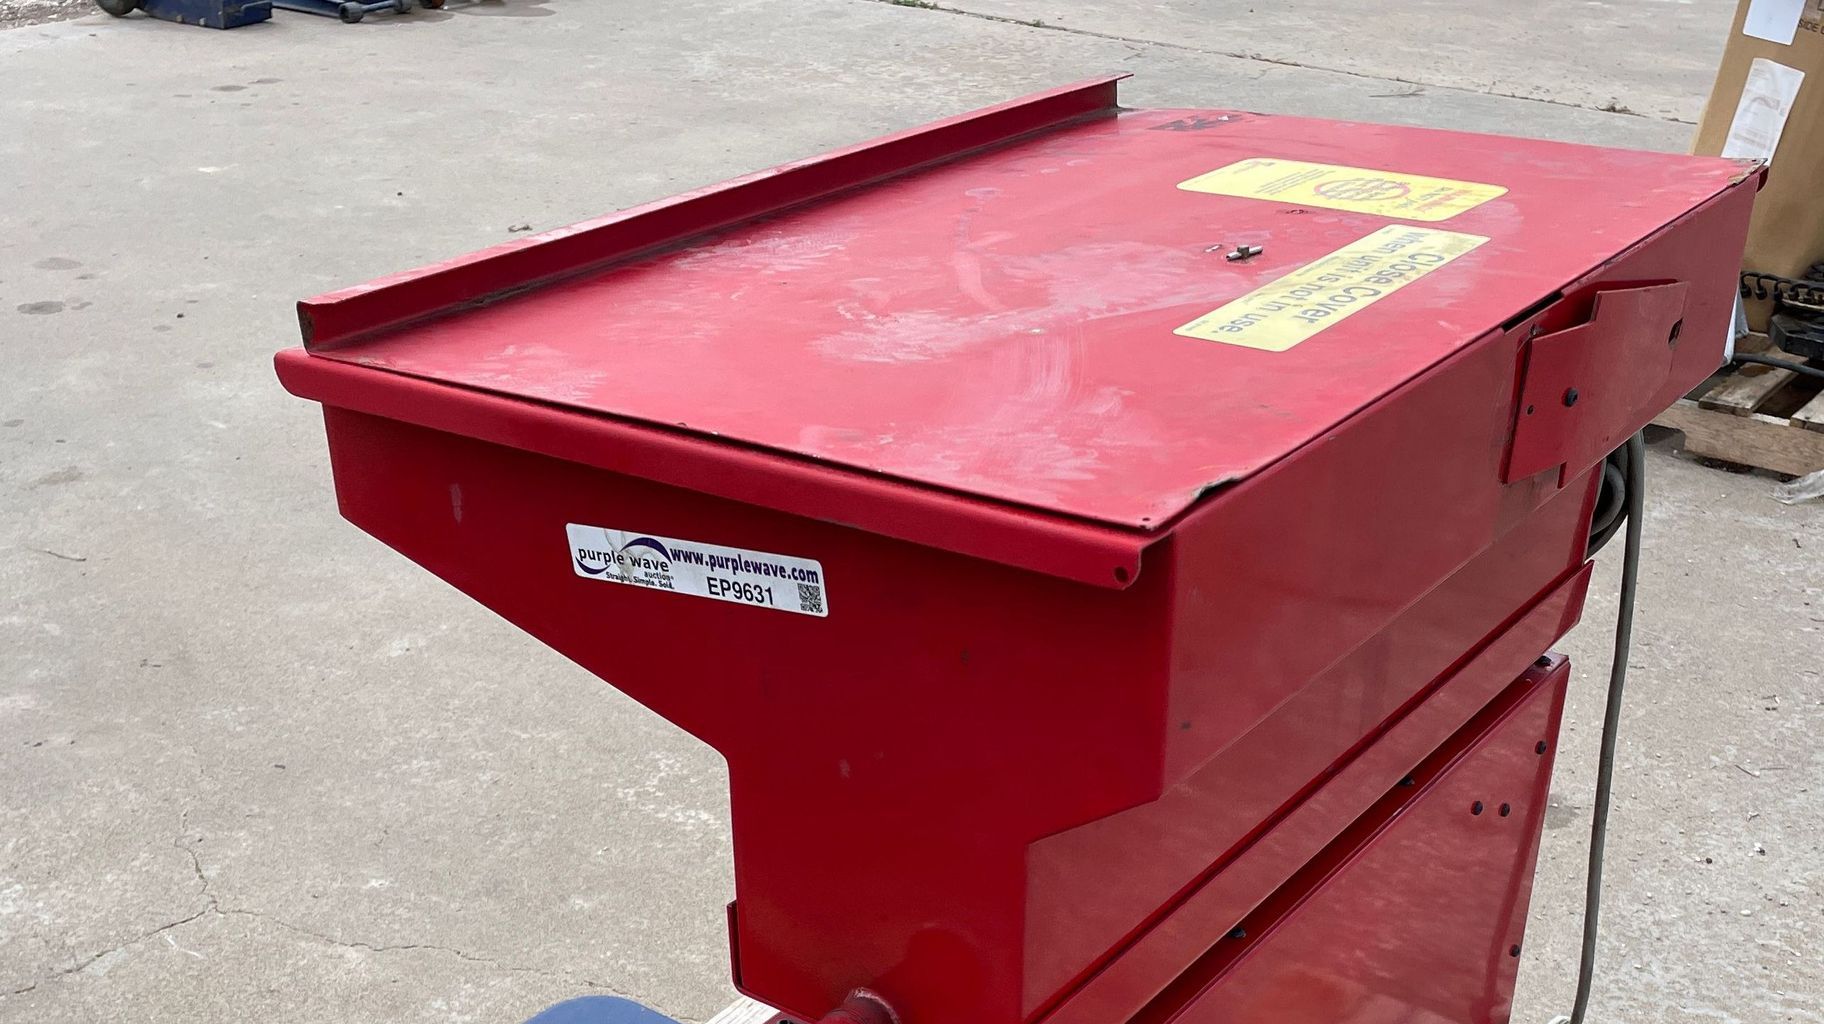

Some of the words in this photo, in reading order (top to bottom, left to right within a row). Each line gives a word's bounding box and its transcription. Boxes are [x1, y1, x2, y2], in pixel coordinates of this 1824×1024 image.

[1317, 272, 1352, 284] is
[1361, 252, 1446, 284] Close
[1289, 282, 1326, 302] not
[1293, 286, 1381, 323] Cover
[1211, 312, 1269, 334] use.
[577, 547, 625, 566] purple
[629, 556, 669, 572] wave
[669, 547, 820, 584] www.purplewave.com
[706, 576, 774, 605] EP9631
